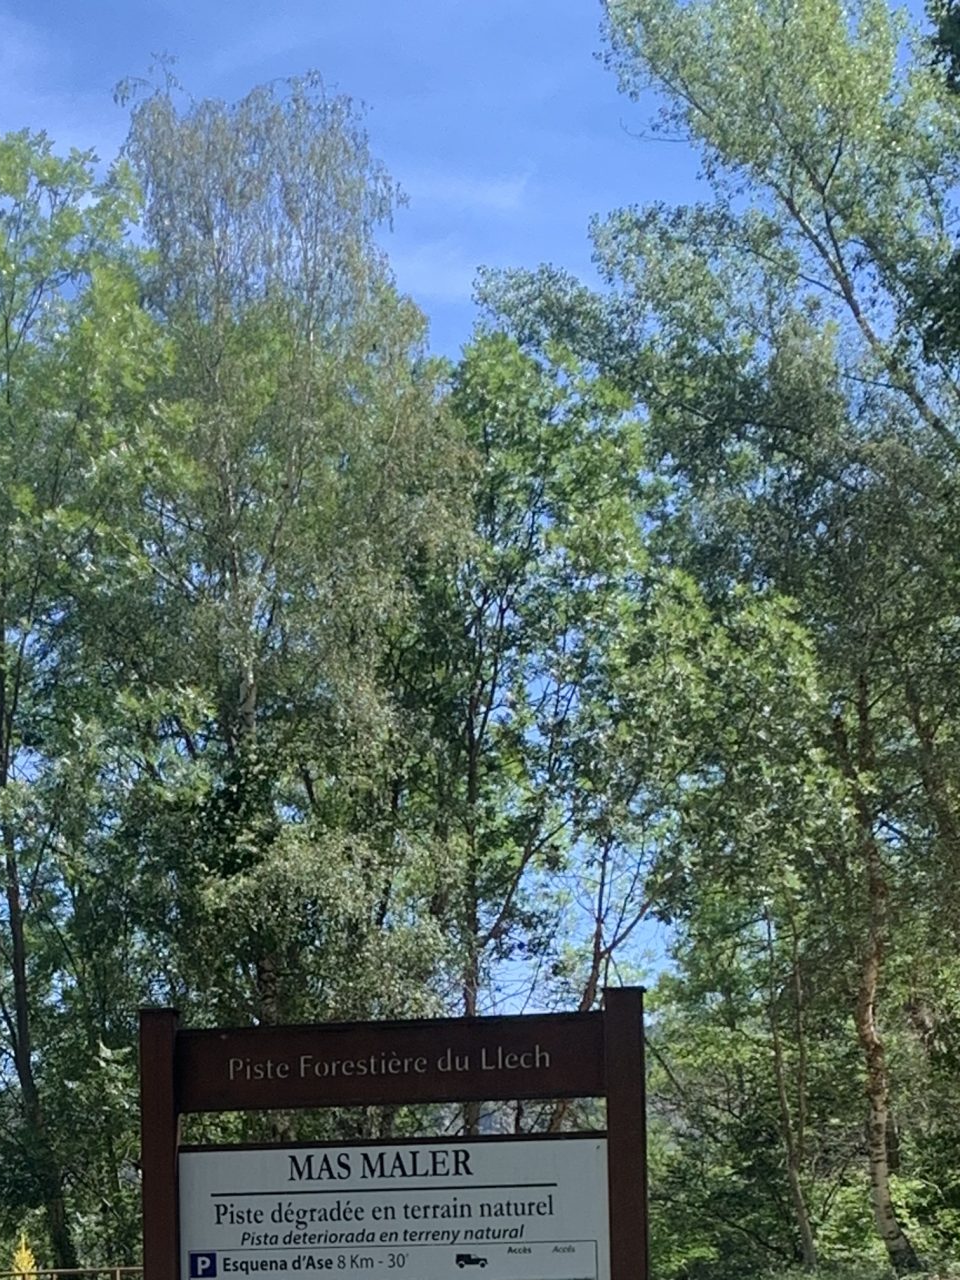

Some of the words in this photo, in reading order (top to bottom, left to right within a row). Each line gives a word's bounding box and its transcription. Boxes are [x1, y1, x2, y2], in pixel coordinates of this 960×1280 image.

[229, 1058, 289, 1080] Piste
[300, 1051, 426, 1078] Forestière
[438, 1048, 469, 1071] du
[481, 1044, 551, 1070] Llech
[288, 1152, 352, 1181] MAS
[360, 1149, 473, 1179] MALER
[214, 1203, 264, 1225] Piste
[271, 1200, 364, 1230] dégradée
[371, 1205, 396, 1221] en
[404, 1197, 472, 1220] terrain
[480, 1194, 554, 1217] naturel
[241, 1231, 278, 1246] Pista
[282, 1229, 377, 1245] deteriorada
[379, 1231, 398, 1242] en
[403, 1227, 460, 1244] terreny
[464, 1224, 525, 1240] natural
[197, 1256, 211, 1275] P
[222, 1257, 288, 1275] Esquena
[292, 1255, 333, 1270] d'Ase
[337, 1254, 346, 1269] 8
[350, 1254, 374, 1268] Km
